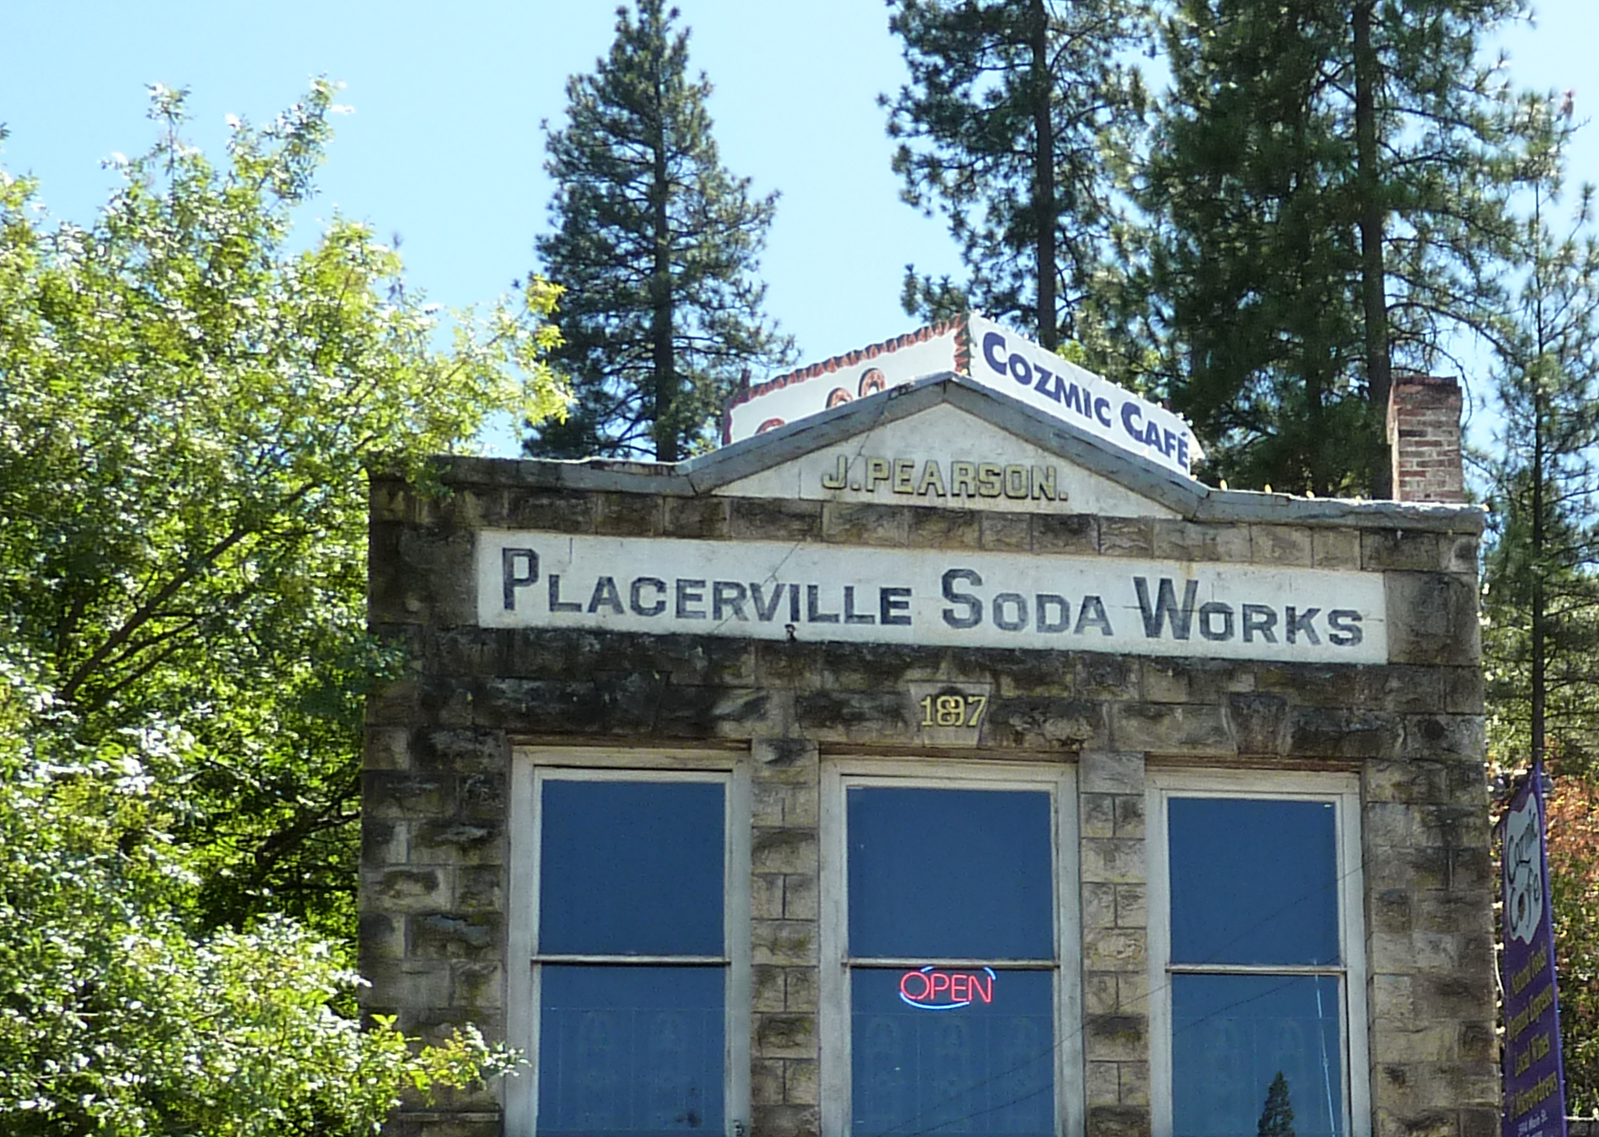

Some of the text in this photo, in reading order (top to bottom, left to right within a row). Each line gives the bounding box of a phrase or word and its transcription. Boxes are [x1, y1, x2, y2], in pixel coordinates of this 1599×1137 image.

[983, 332, 1111, 428] COZMIC
[1121, 402, 1189, 469] CAFÉ
[502, 547, 1364, 648] PLACERVILLE SODA WORKS
[900, 971, 994, 1003] OPEN
